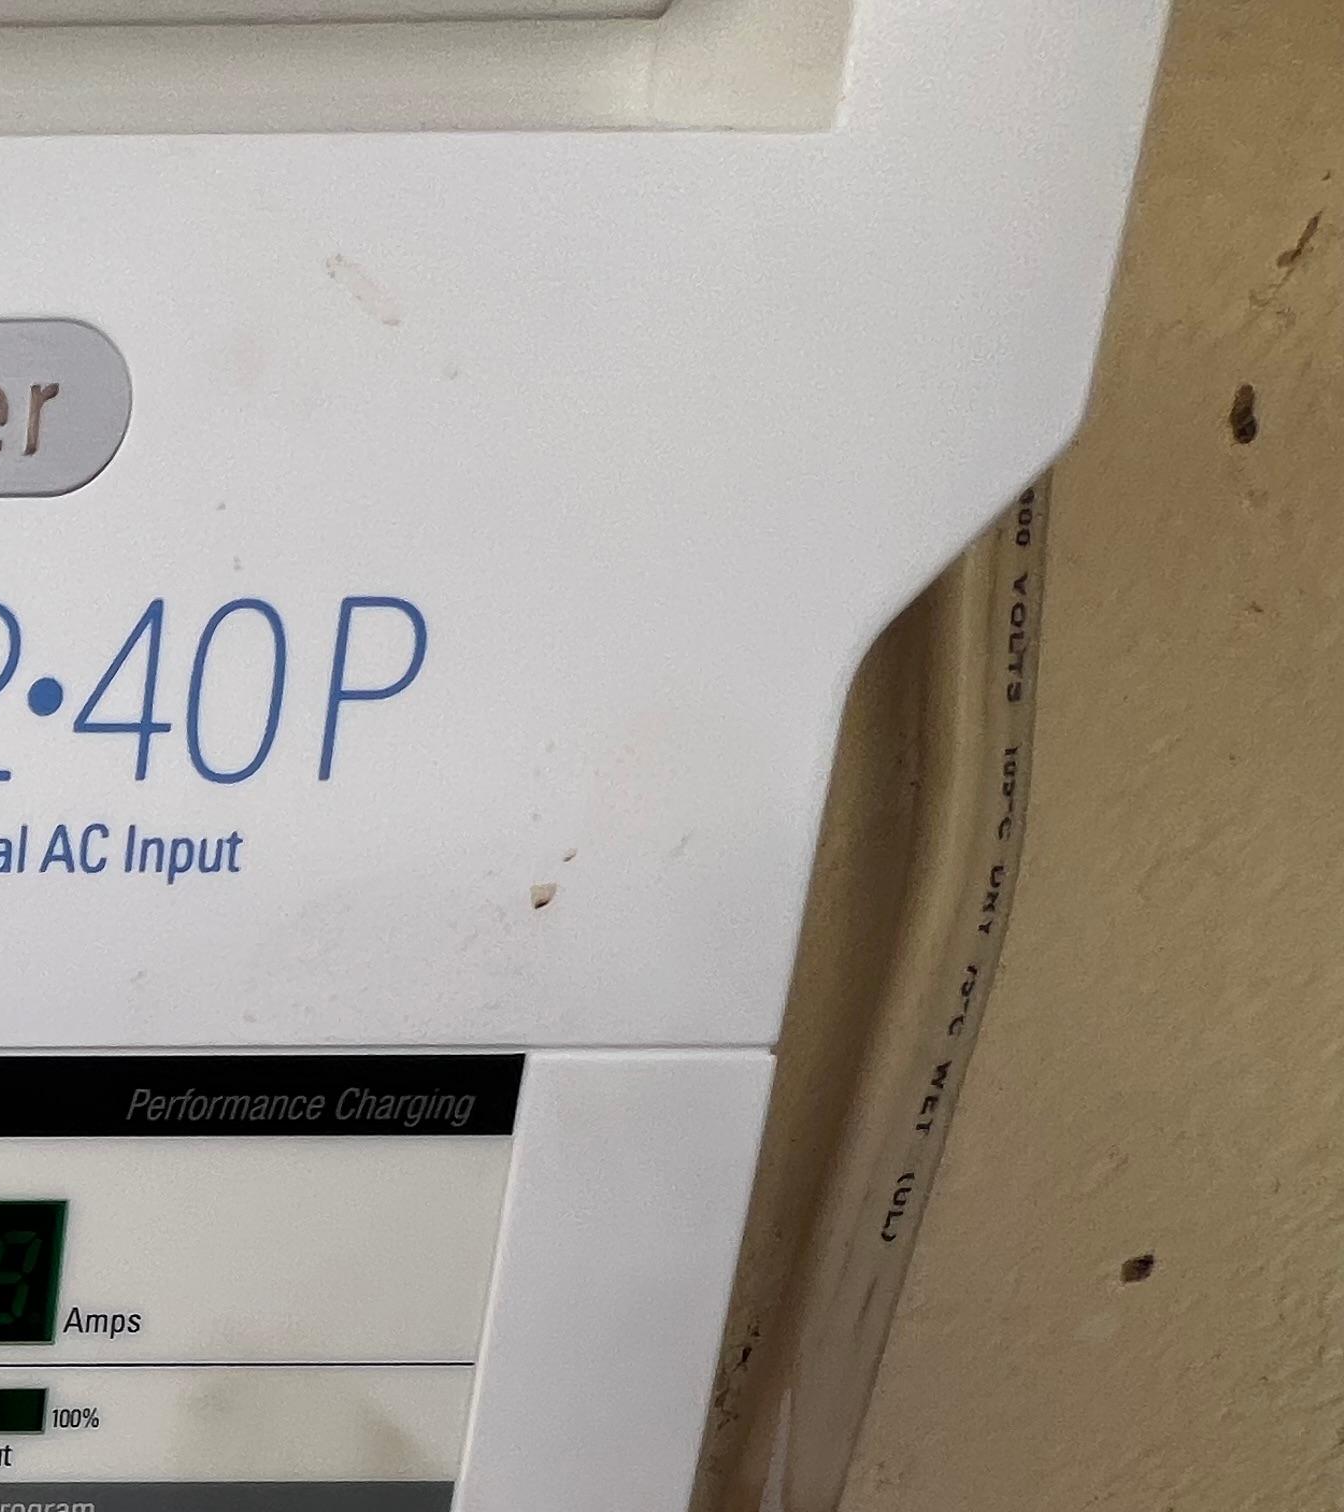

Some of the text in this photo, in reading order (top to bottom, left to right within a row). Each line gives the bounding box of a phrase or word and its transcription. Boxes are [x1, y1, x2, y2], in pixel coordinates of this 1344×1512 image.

[1006, 571, 1029, 705] VOLTS
[38, 823, 110, 875] AC
[124, 824, 244, 886] Input
[125, 1087, 476, 1128] Performance Charging
[915, 1060, 953, 1136] WET
[62, 1306, 142, 1340] Amps
[52, 1407, 100, 1429] 100%
